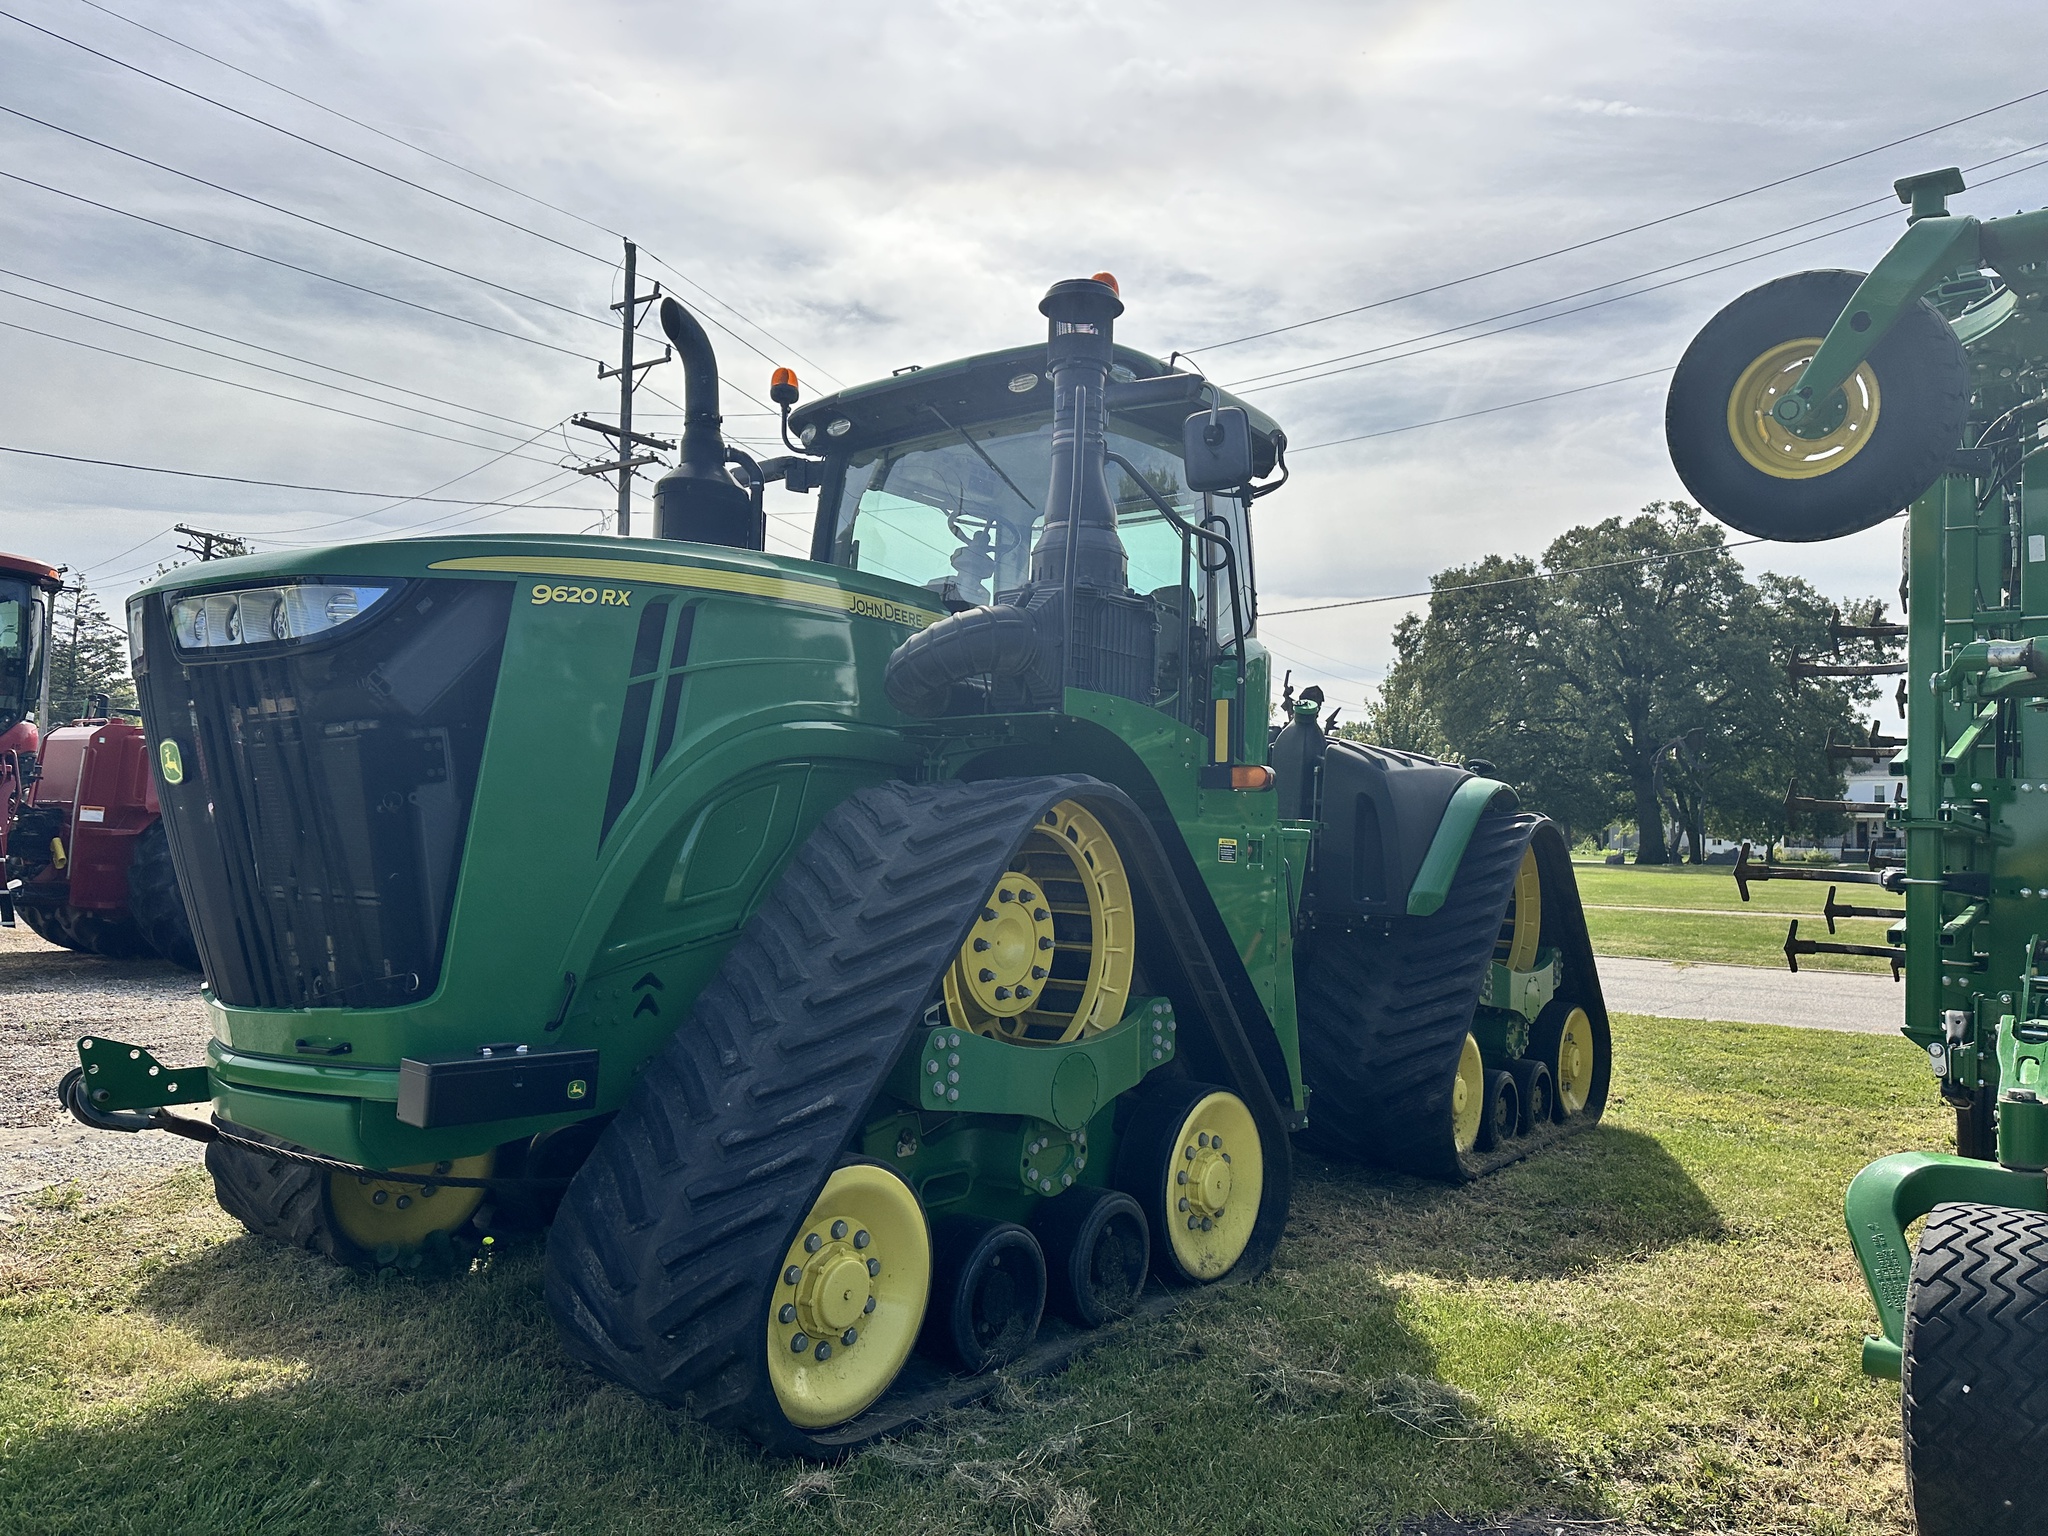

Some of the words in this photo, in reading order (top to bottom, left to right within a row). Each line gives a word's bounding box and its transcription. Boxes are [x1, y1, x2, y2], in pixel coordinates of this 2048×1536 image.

[531, 584, 598, 605] 9620
[601, 589, 632, 606] RX
[849, 596, 883, 617] JOHN
[884, 602, 923, 627] DEERE
